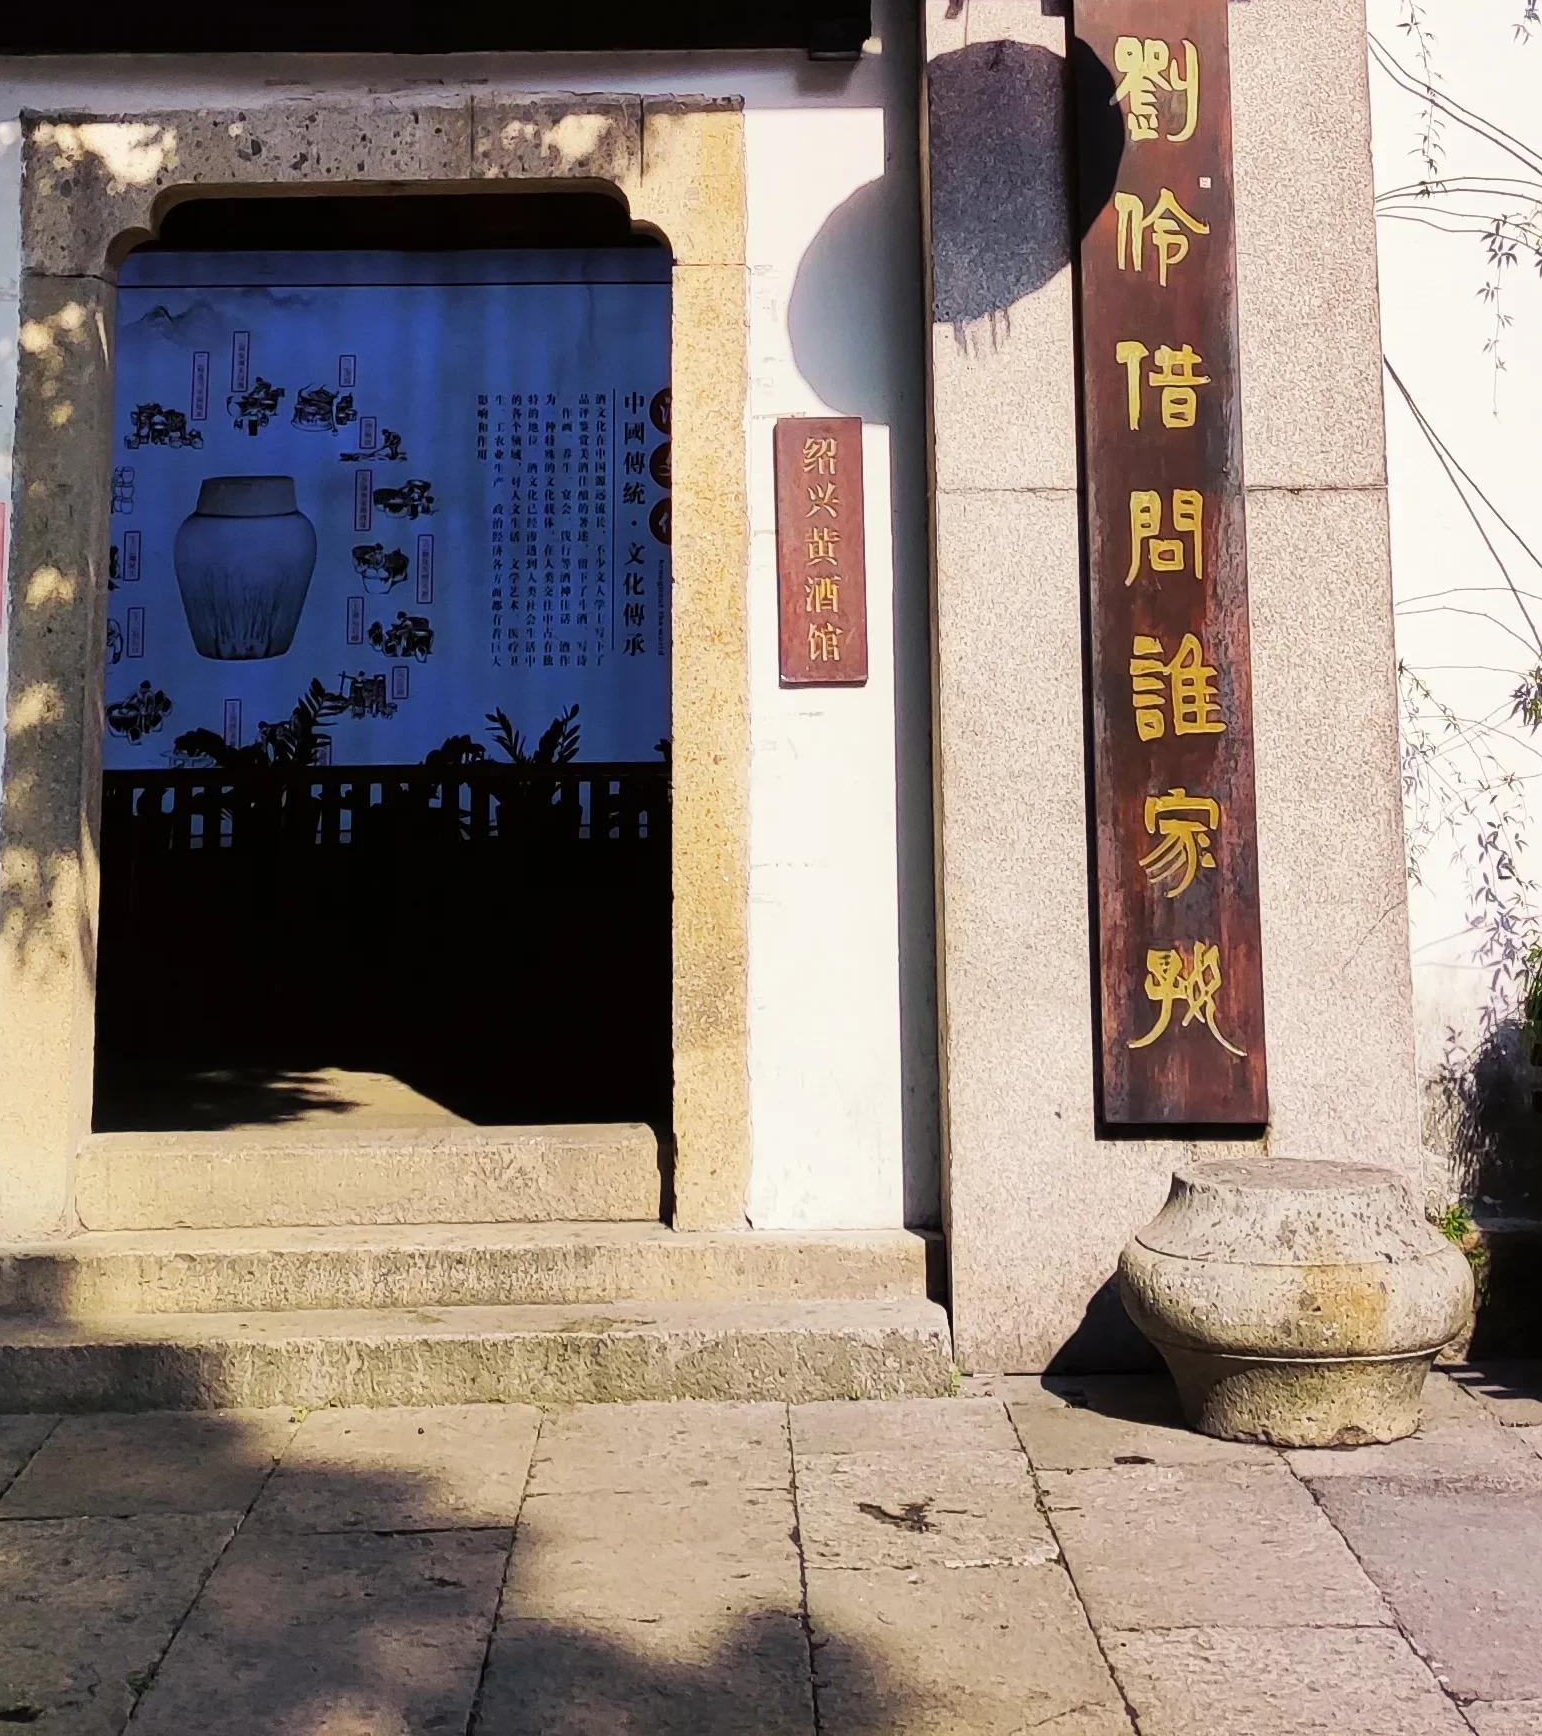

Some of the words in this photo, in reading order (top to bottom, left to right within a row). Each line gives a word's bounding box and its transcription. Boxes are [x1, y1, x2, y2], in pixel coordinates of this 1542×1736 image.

[802, 437, 843, 662] 绍兴黄酒馆
